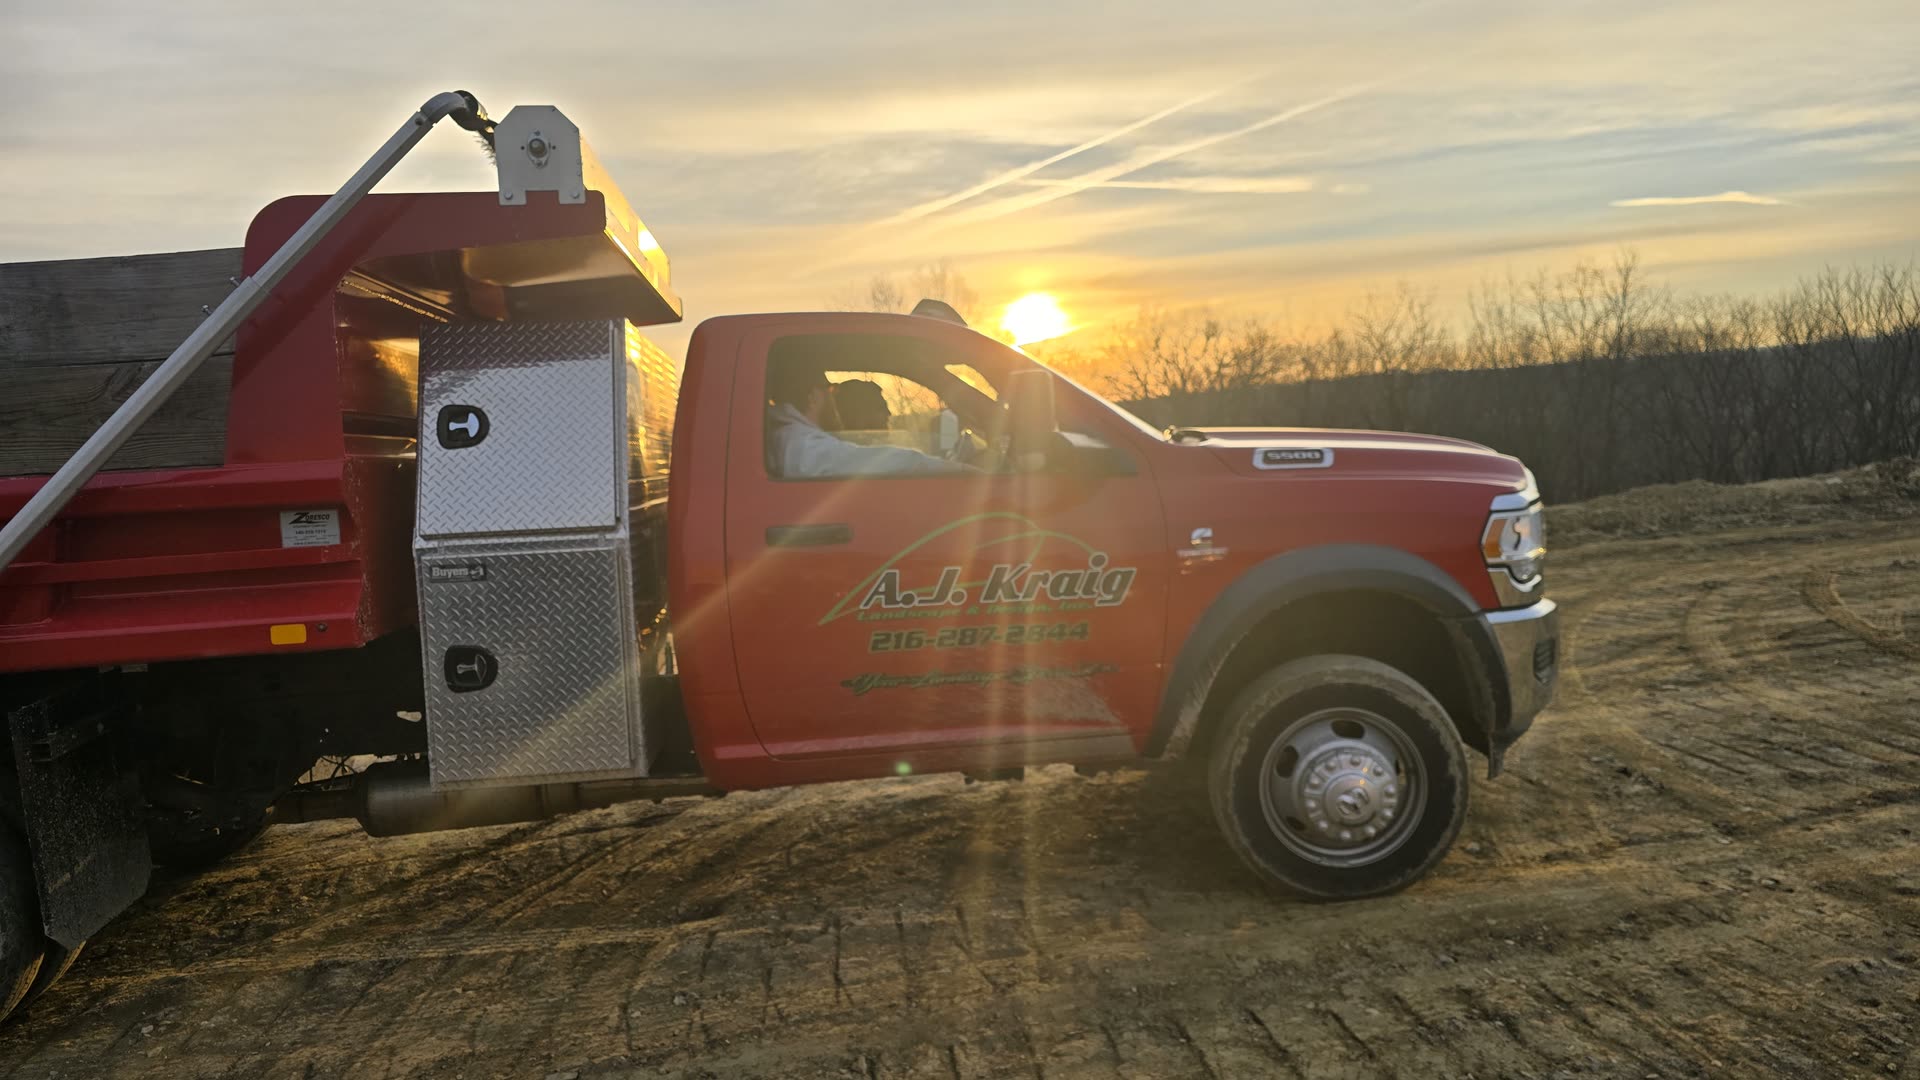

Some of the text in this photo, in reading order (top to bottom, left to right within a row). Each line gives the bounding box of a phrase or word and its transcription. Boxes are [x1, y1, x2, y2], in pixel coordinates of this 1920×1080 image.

[288, 511, 330, 525] ZORESCO
[432, 566, 469, 579] Buyers
[859, 551, 1137, 609] A.J. Kraig
